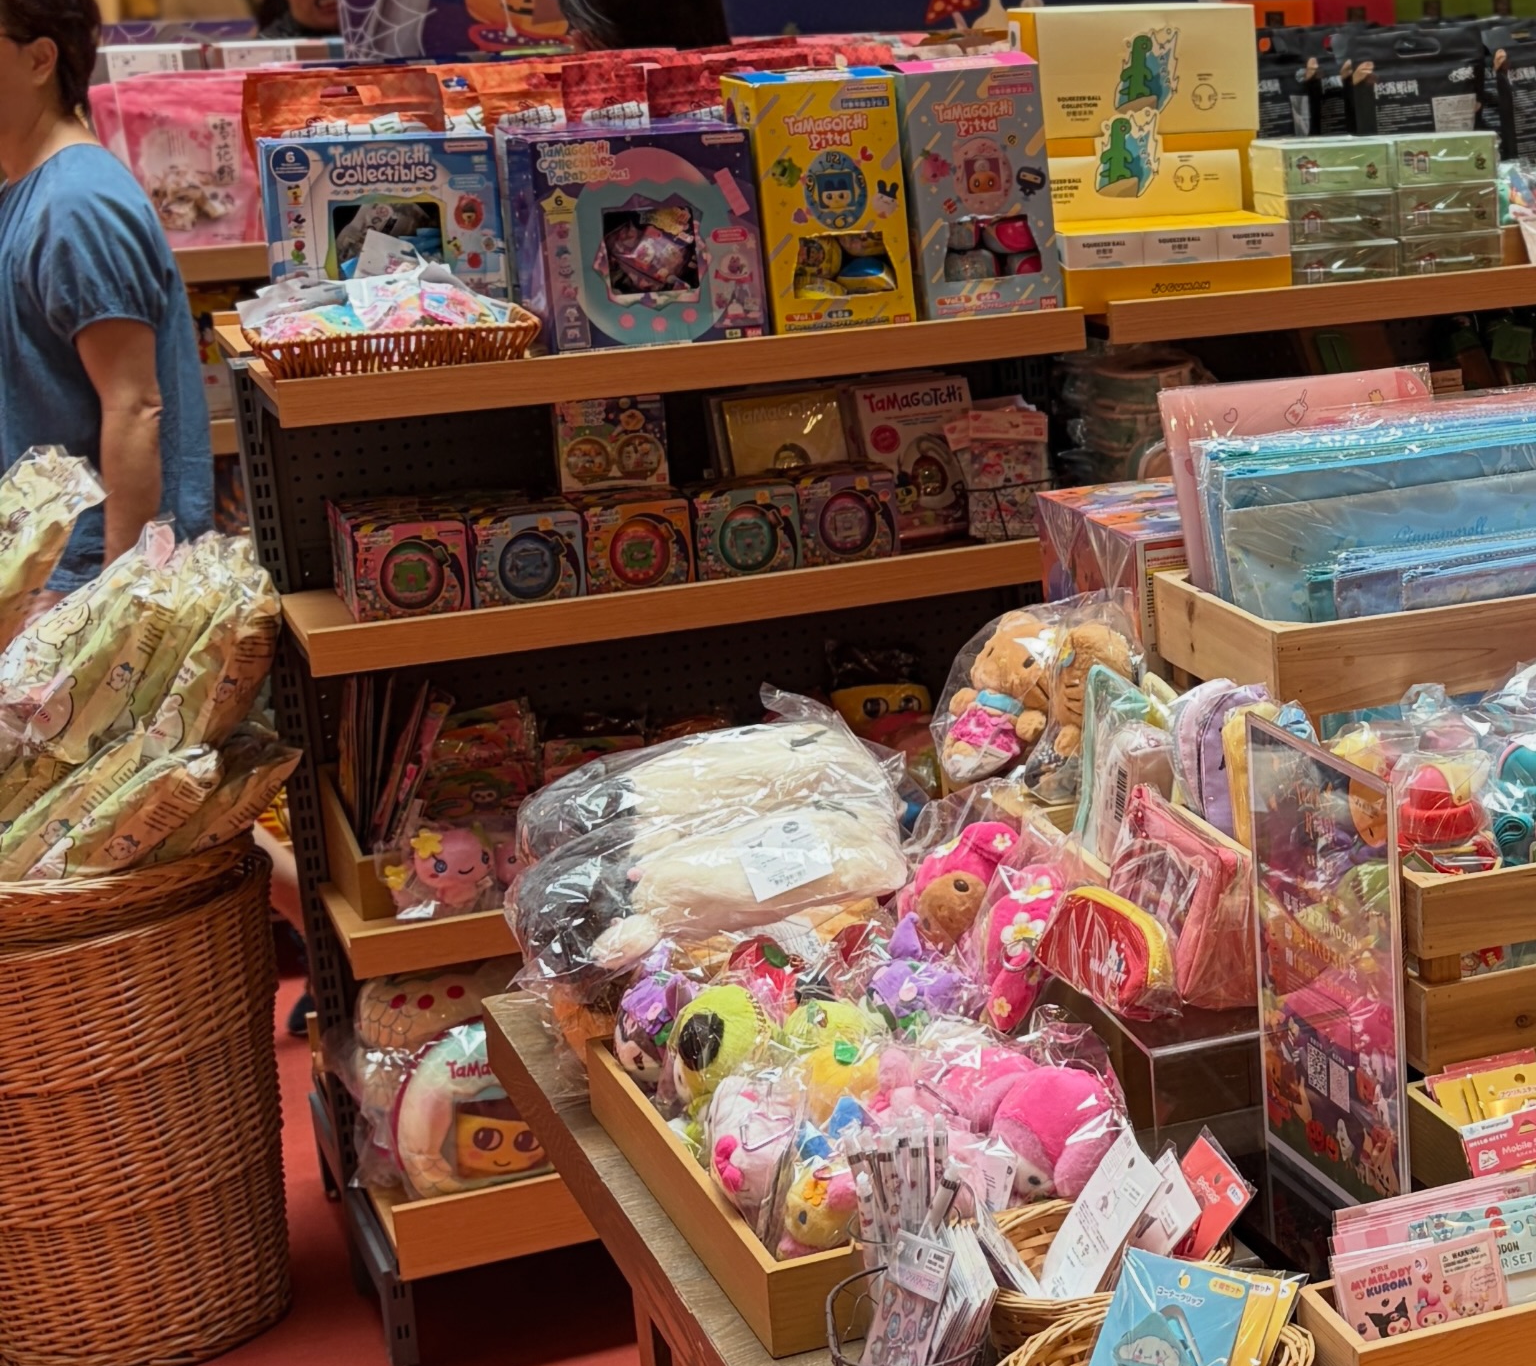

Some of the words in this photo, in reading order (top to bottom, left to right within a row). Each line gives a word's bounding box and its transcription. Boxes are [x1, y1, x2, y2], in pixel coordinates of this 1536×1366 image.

[284, 151, 296, 163] 6
[331, 165, 435, 185] Collectibles
[554, 195, 564, 206] 6
[1501, 1140, 1533, 1156] Mobile
[1350, 1278, 1367, 1292] MY
[1367, 1266, 1412, 1287] MELODY
[1365, 1276, 1413, 1298] KUROMI
